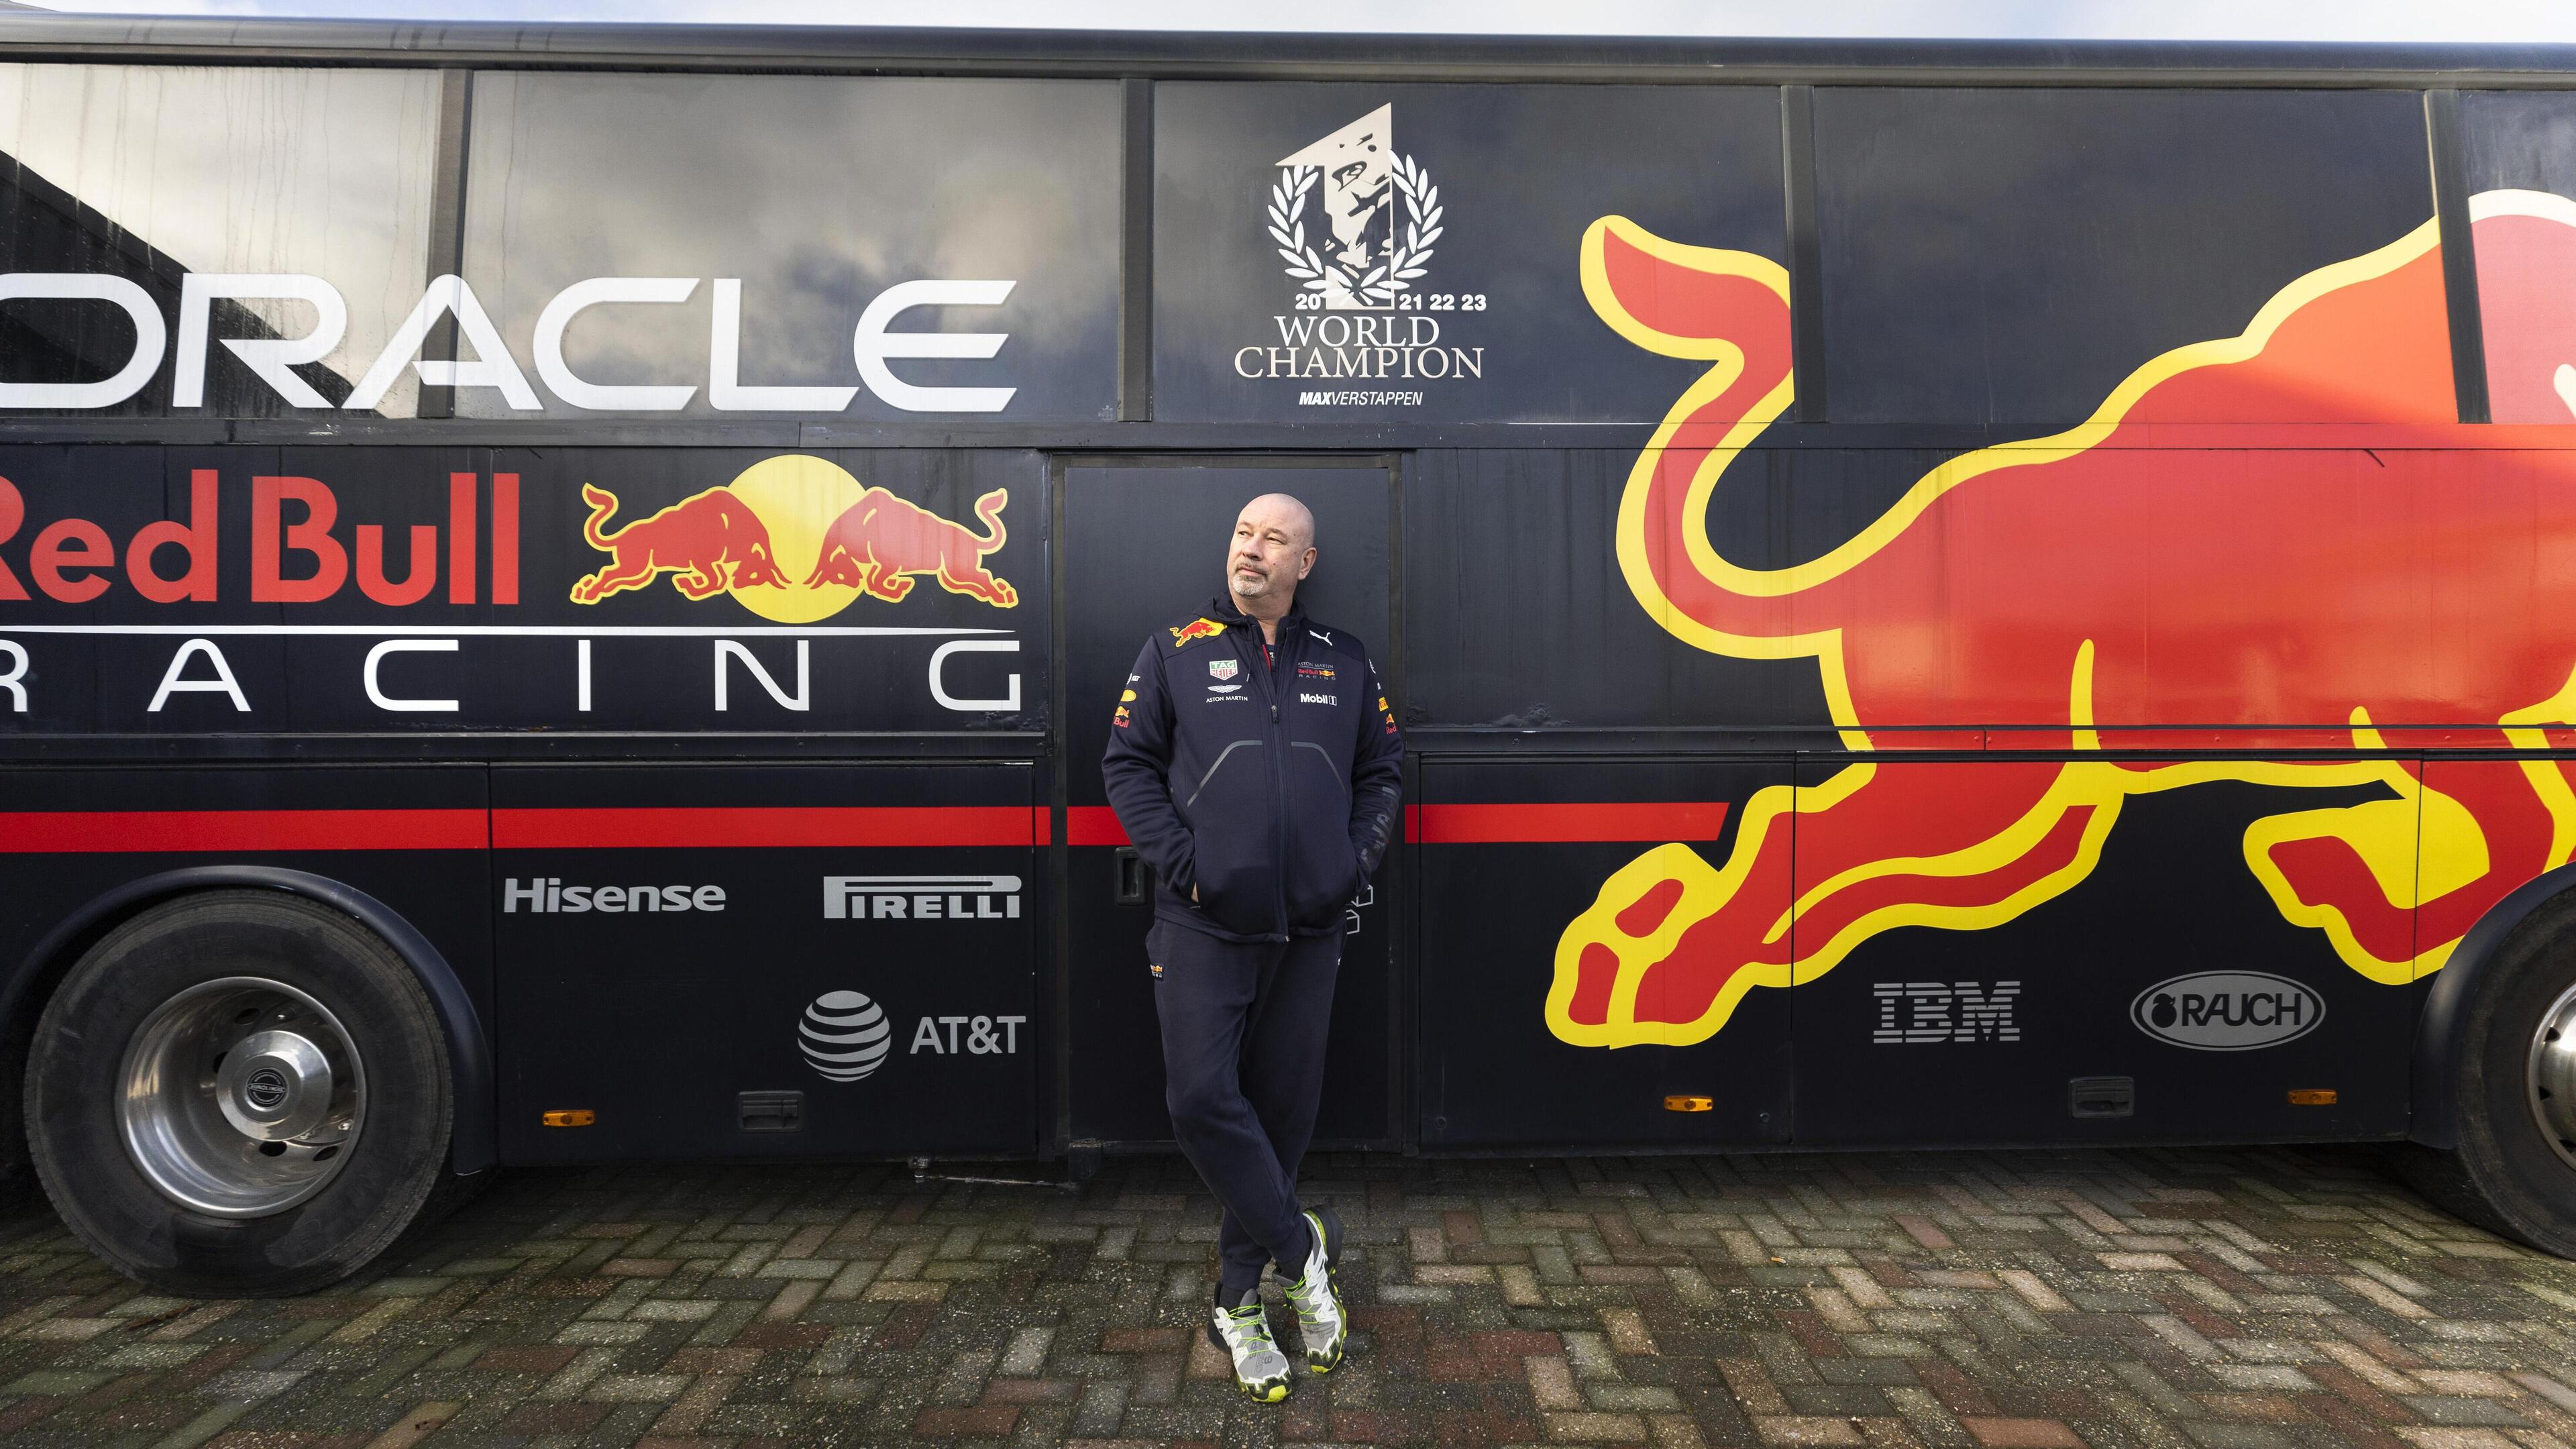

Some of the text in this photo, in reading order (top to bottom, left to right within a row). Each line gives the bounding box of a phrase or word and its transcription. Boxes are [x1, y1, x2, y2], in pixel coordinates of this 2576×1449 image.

[1295, 293, 1487, 311] 20 21 22 23
[0, 272, 1018, 413] ORACLE
[1273, 315, 1440, 347] WORLD
[1234, 346, 1485, 378] CHAMPION
[251, 472, 519, 606] Bull
[1212, 669, 1236, 679] HEUER
[1299, 693, 1328, 704] Mobil
[1114, 717, 1130, 728] Bull
[1386, 723, 1397, 735] Red
[504, 877, 726, 913] Hisense
[823, 875, 1022, 919] PIRELLI
[1873, 981, 2021, 1044] IBM
[2181, 992, 2302, 1028] RAUCH
[910, 1015, 1026, 1055] AT&T
